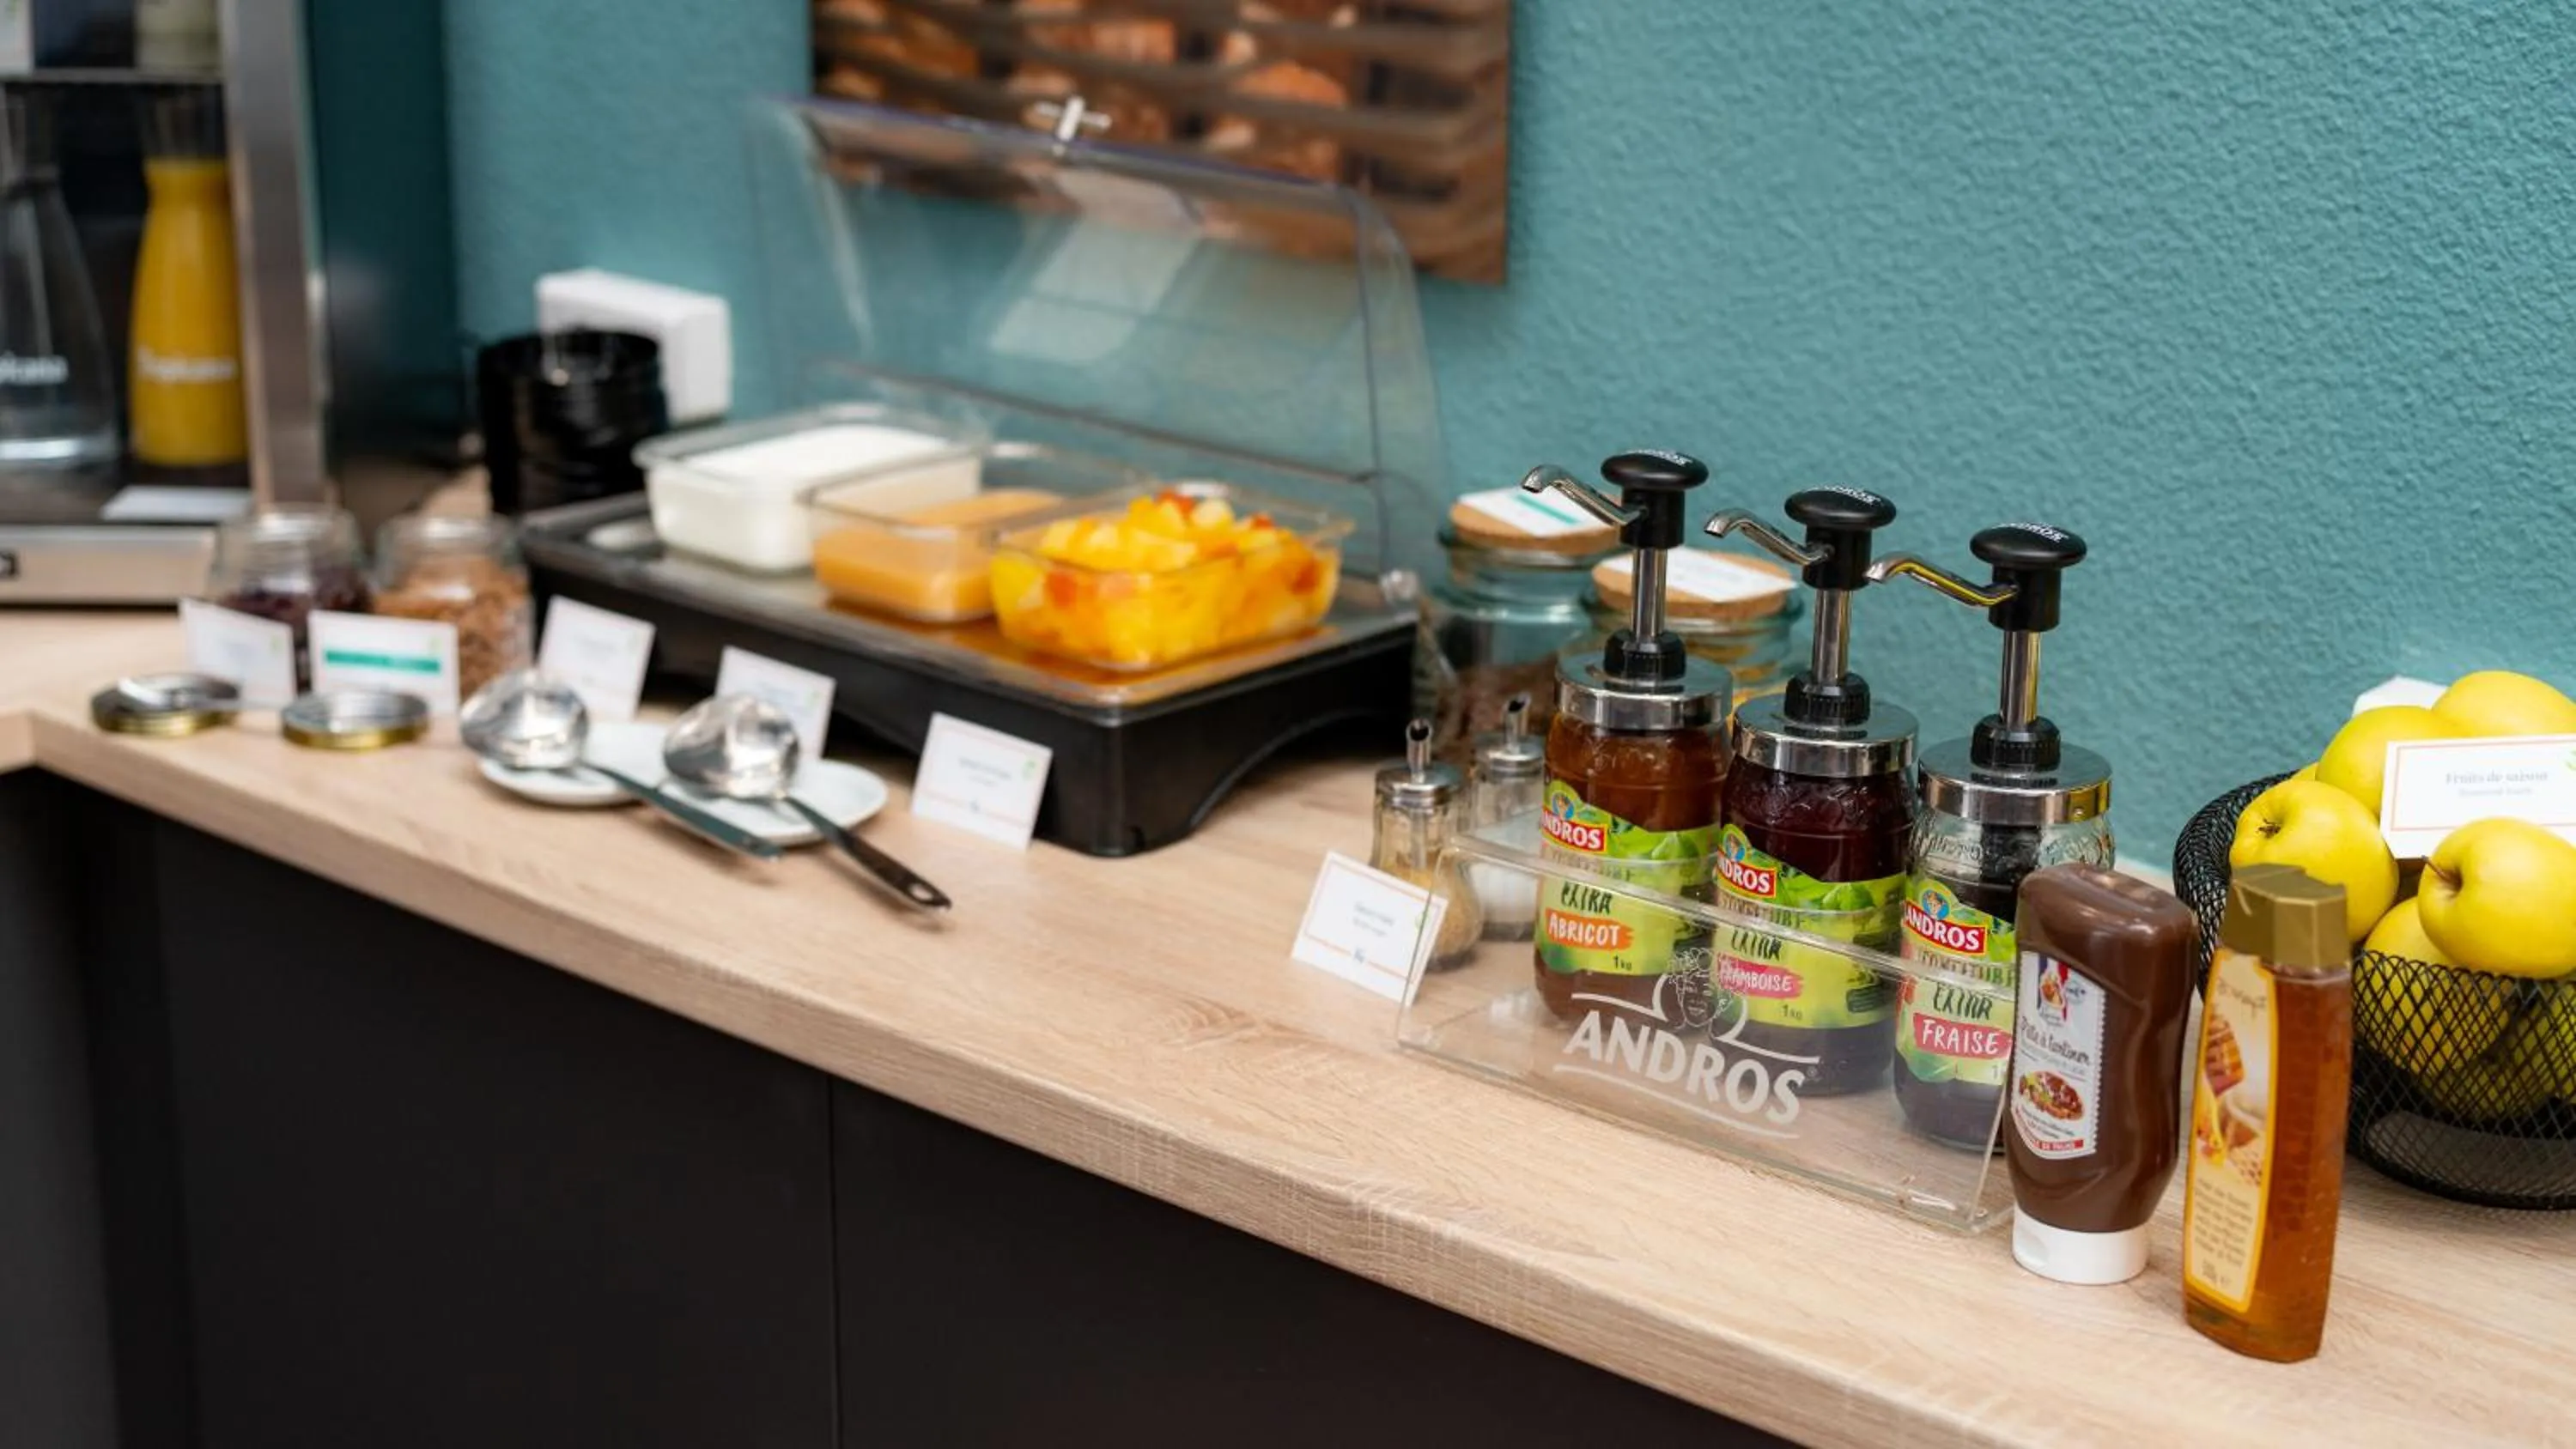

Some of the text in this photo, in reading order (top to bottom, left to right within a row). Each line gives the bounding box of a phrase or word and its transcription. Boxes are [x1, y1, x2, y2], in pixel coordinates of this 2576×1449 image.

[2445, 771, 2485, 785] Fruits
[1542, 810, 1601, 850] NDROS
[1717, 856, 1771, 894] NDROS
[1548, 912, 1621, 948] ABRICOT
[1904, 903, 1980, 950] ANDROS
[1922, 1018, 2000, 1056] FRAISE
[1562, 1010, 1805, 1125] ANDROS
